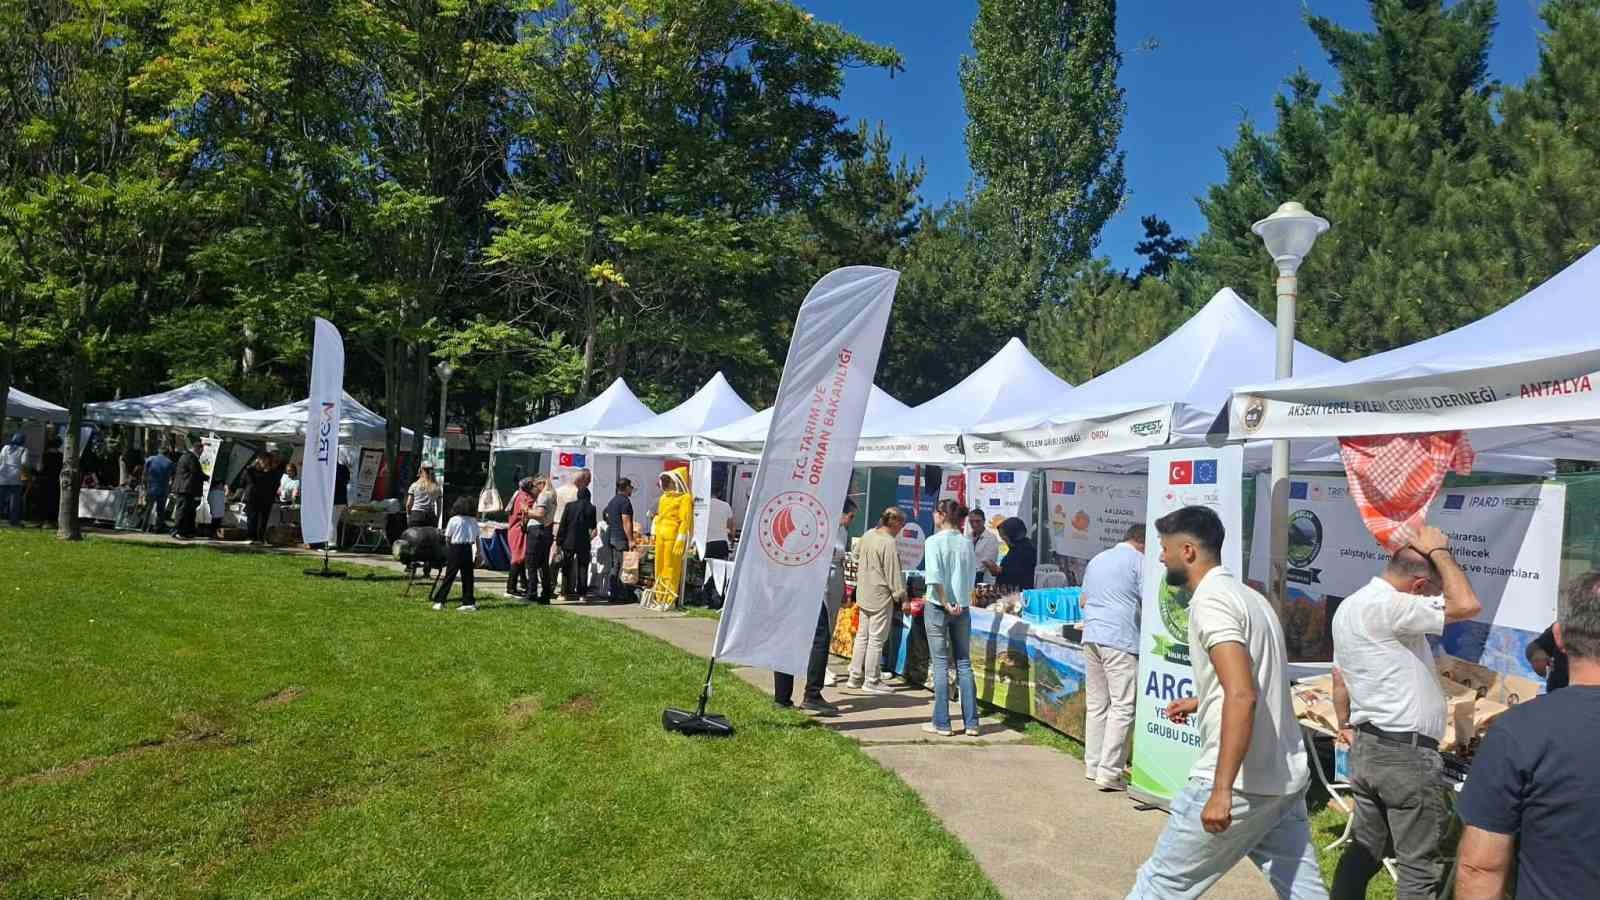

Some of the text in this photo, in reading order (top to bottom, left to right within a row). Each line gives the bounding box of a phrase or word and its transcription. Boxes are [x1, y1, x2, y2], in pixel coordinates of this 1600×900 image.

[1389, 398, 1430, 412] GRUBU
[1431, 386, 1497, 409] DERNEĞİ
[1520, 376, 1592, 399] ANTALYA
[800, 407, 821, 451] TARIM
[815, 383, 827, 402] VE
[808, 430, 832, 485] ORMAN
[1470, 564, 1481, 573] ve
[1145, 670, 1193, 701] ARG
[1147, 722, 1200, 748] GRUBU DER
